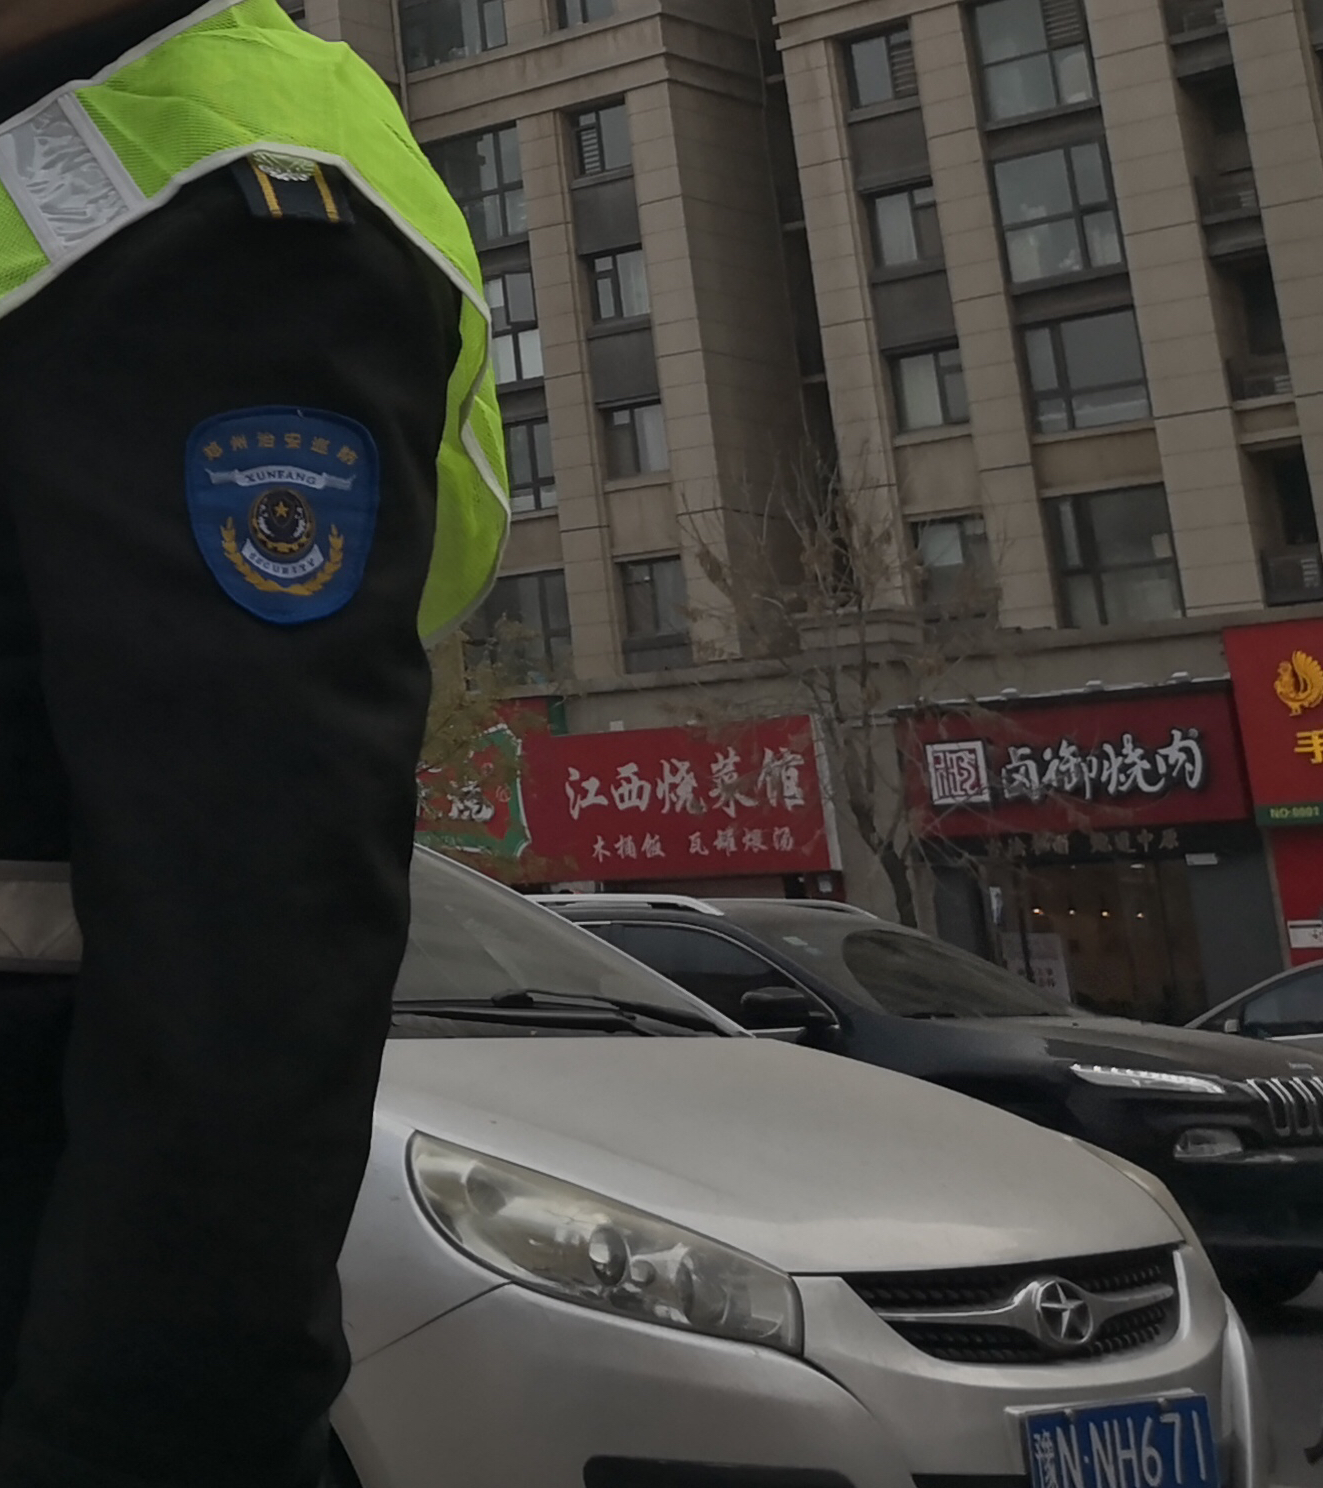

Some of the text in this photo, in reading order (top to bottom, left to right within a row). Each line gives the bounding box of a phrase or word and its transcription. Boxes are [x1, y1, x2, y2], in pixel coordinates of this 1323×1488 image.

[246, 470, 318, 485] XUNFANG
[248, 552, 317, 575] SECURITY
[564, 745, 806, 820] 江西烧菜馆
[590, 826, 795, 863] 木桶饭 瓦罐煨汤
